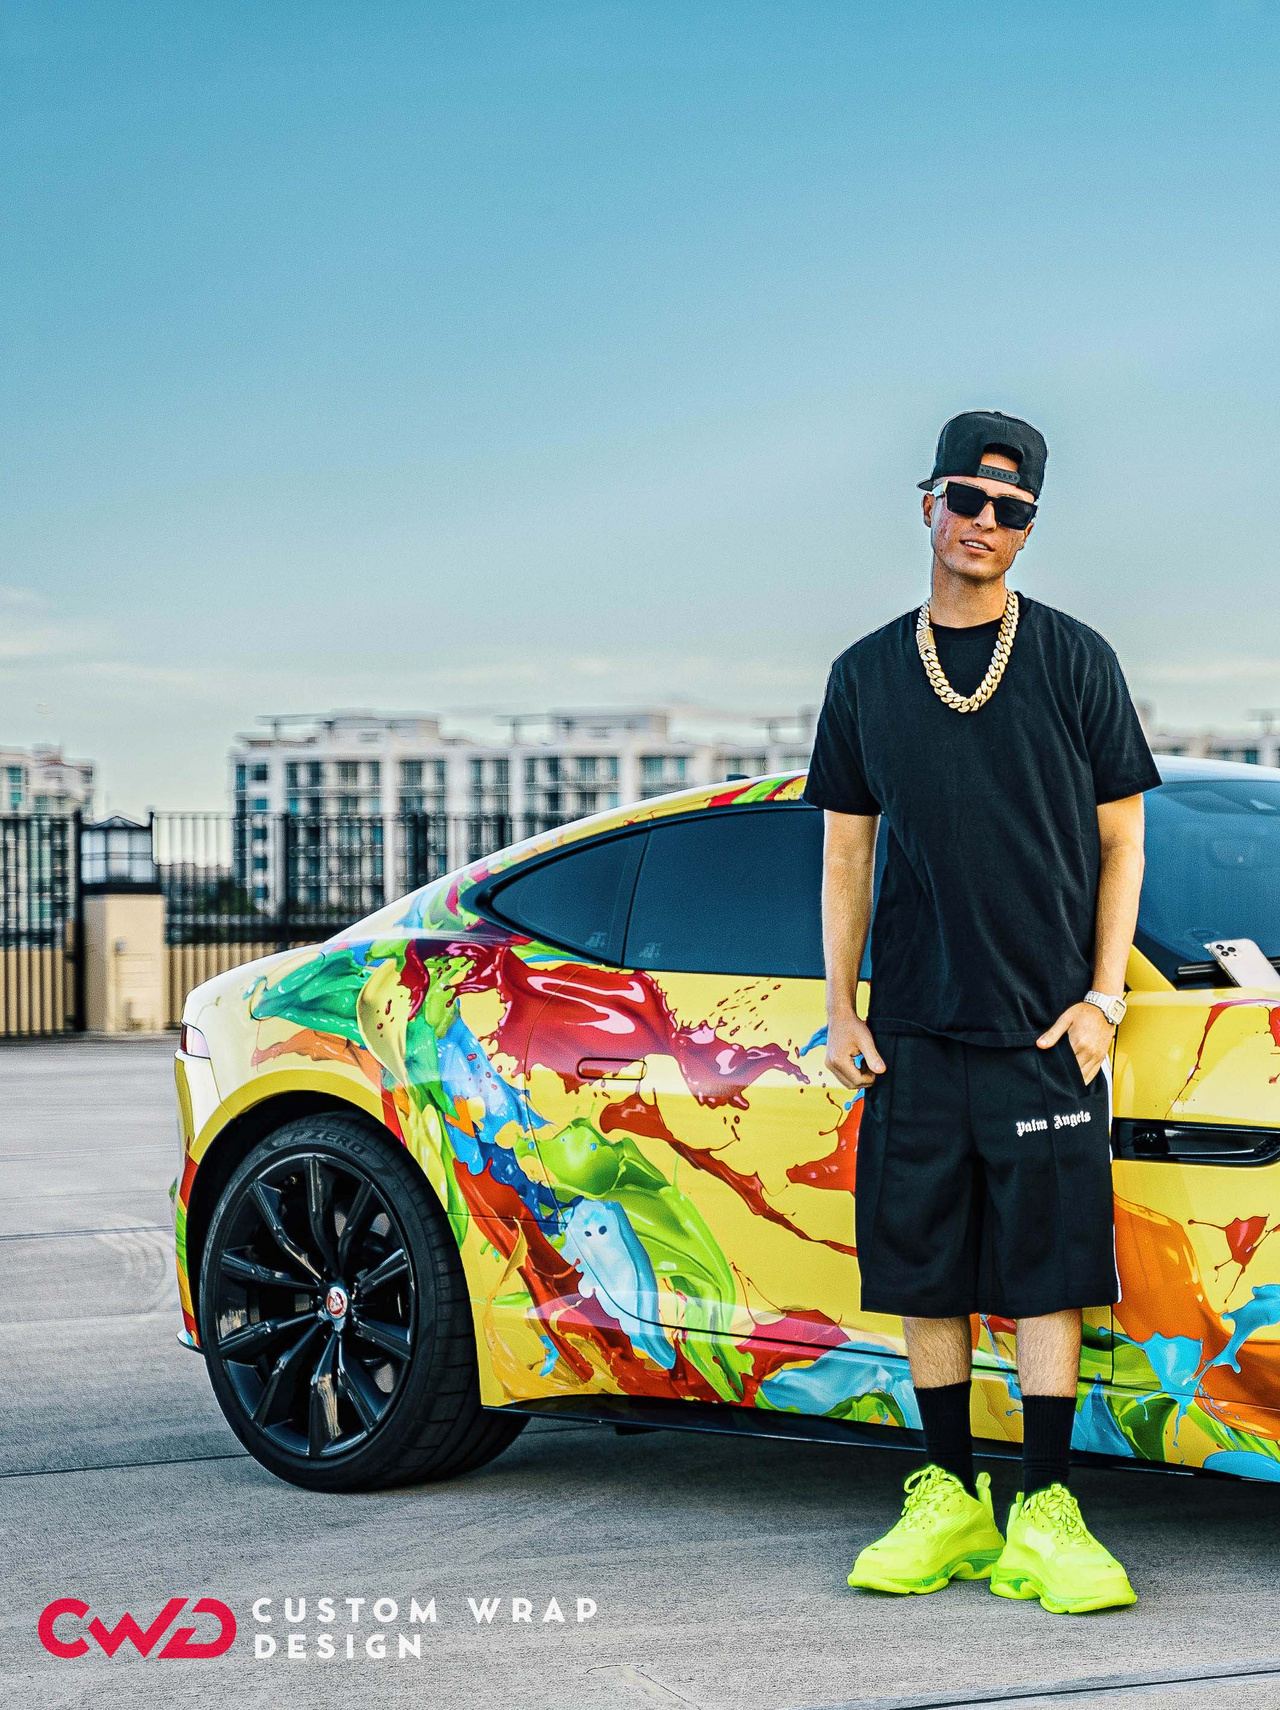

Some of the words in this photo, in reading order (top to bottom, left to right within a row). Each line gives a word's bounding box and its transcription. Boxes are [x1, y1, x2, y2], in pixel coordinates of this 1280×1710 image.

[1015, 1119, 1048, 1137] Palm
[1053, 1110, 1092, 1130] Angels
[306, 1129, 366, 1155] ZERO
